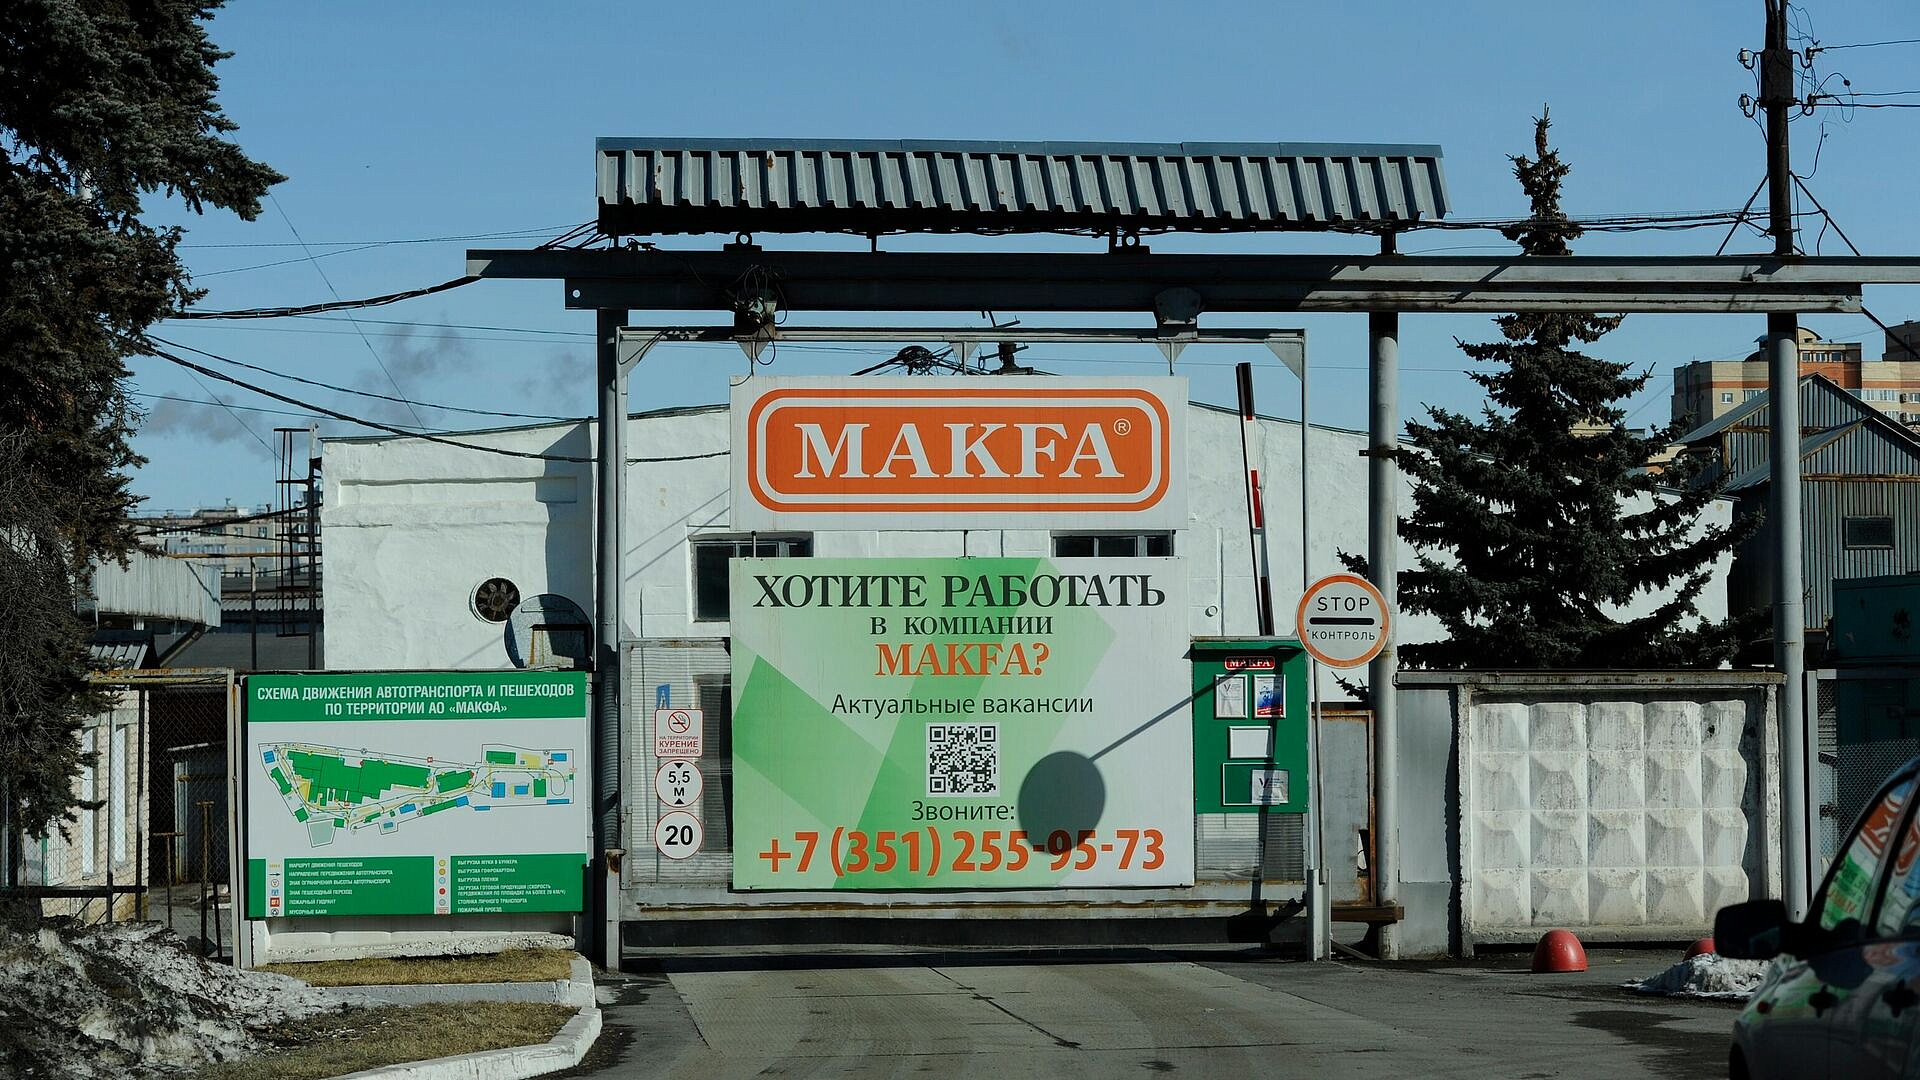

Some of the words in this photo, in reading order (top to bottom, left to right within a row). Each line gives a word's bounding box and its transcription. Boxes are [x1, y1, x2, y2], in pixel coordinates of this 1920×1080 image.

[793, 423, 1125, 478] MAKFA
[753, 575, 927, 608] ХОТИТЕ
[942, 574, 1166, 608] РАБОТАТЬ
[1317, 597, 1370, 611] STOP
[904, 616, 1053, 635] КОМПАНИИ
[1311, 631, 1376, 640] КОНТРОЛЬ
[875, 642, 1050, 676] MAKFA?
[1229, 658, 1271, 667] MAKFA
[257, 687, 299, 700] СХЕМА
[302, 686, 372, 701] ДВИЖЕНИЯ
[376, 685, 483, 699] АВТОТРАНСПОРТА
[488, 685, 496, 697] И
[500, 684, 574, 698] ПЕШЕХОДОВ
[325, 703, 342, 715] ПО
[346, 702, 425, 715] ТЕРРИТОРИИ
[429, 702, 445, 714] АО
[449, 701, 507, 714] «МАКФА»
[832, 694, 976, 719] Актуальные
[984, 698, 1094, 713] вакансии
[659, 740, 699, 748] КУРЕНИЕ
[668, 771, 690, 786] 5,5
[912, 802, 1015, 821] Звоните:
[665, 825, 694, 846] 20
[759, 831, 819, 873] +7
[831, 827, 941, 877] (351)
[953, 829, 1165, 872] 255-95-73
